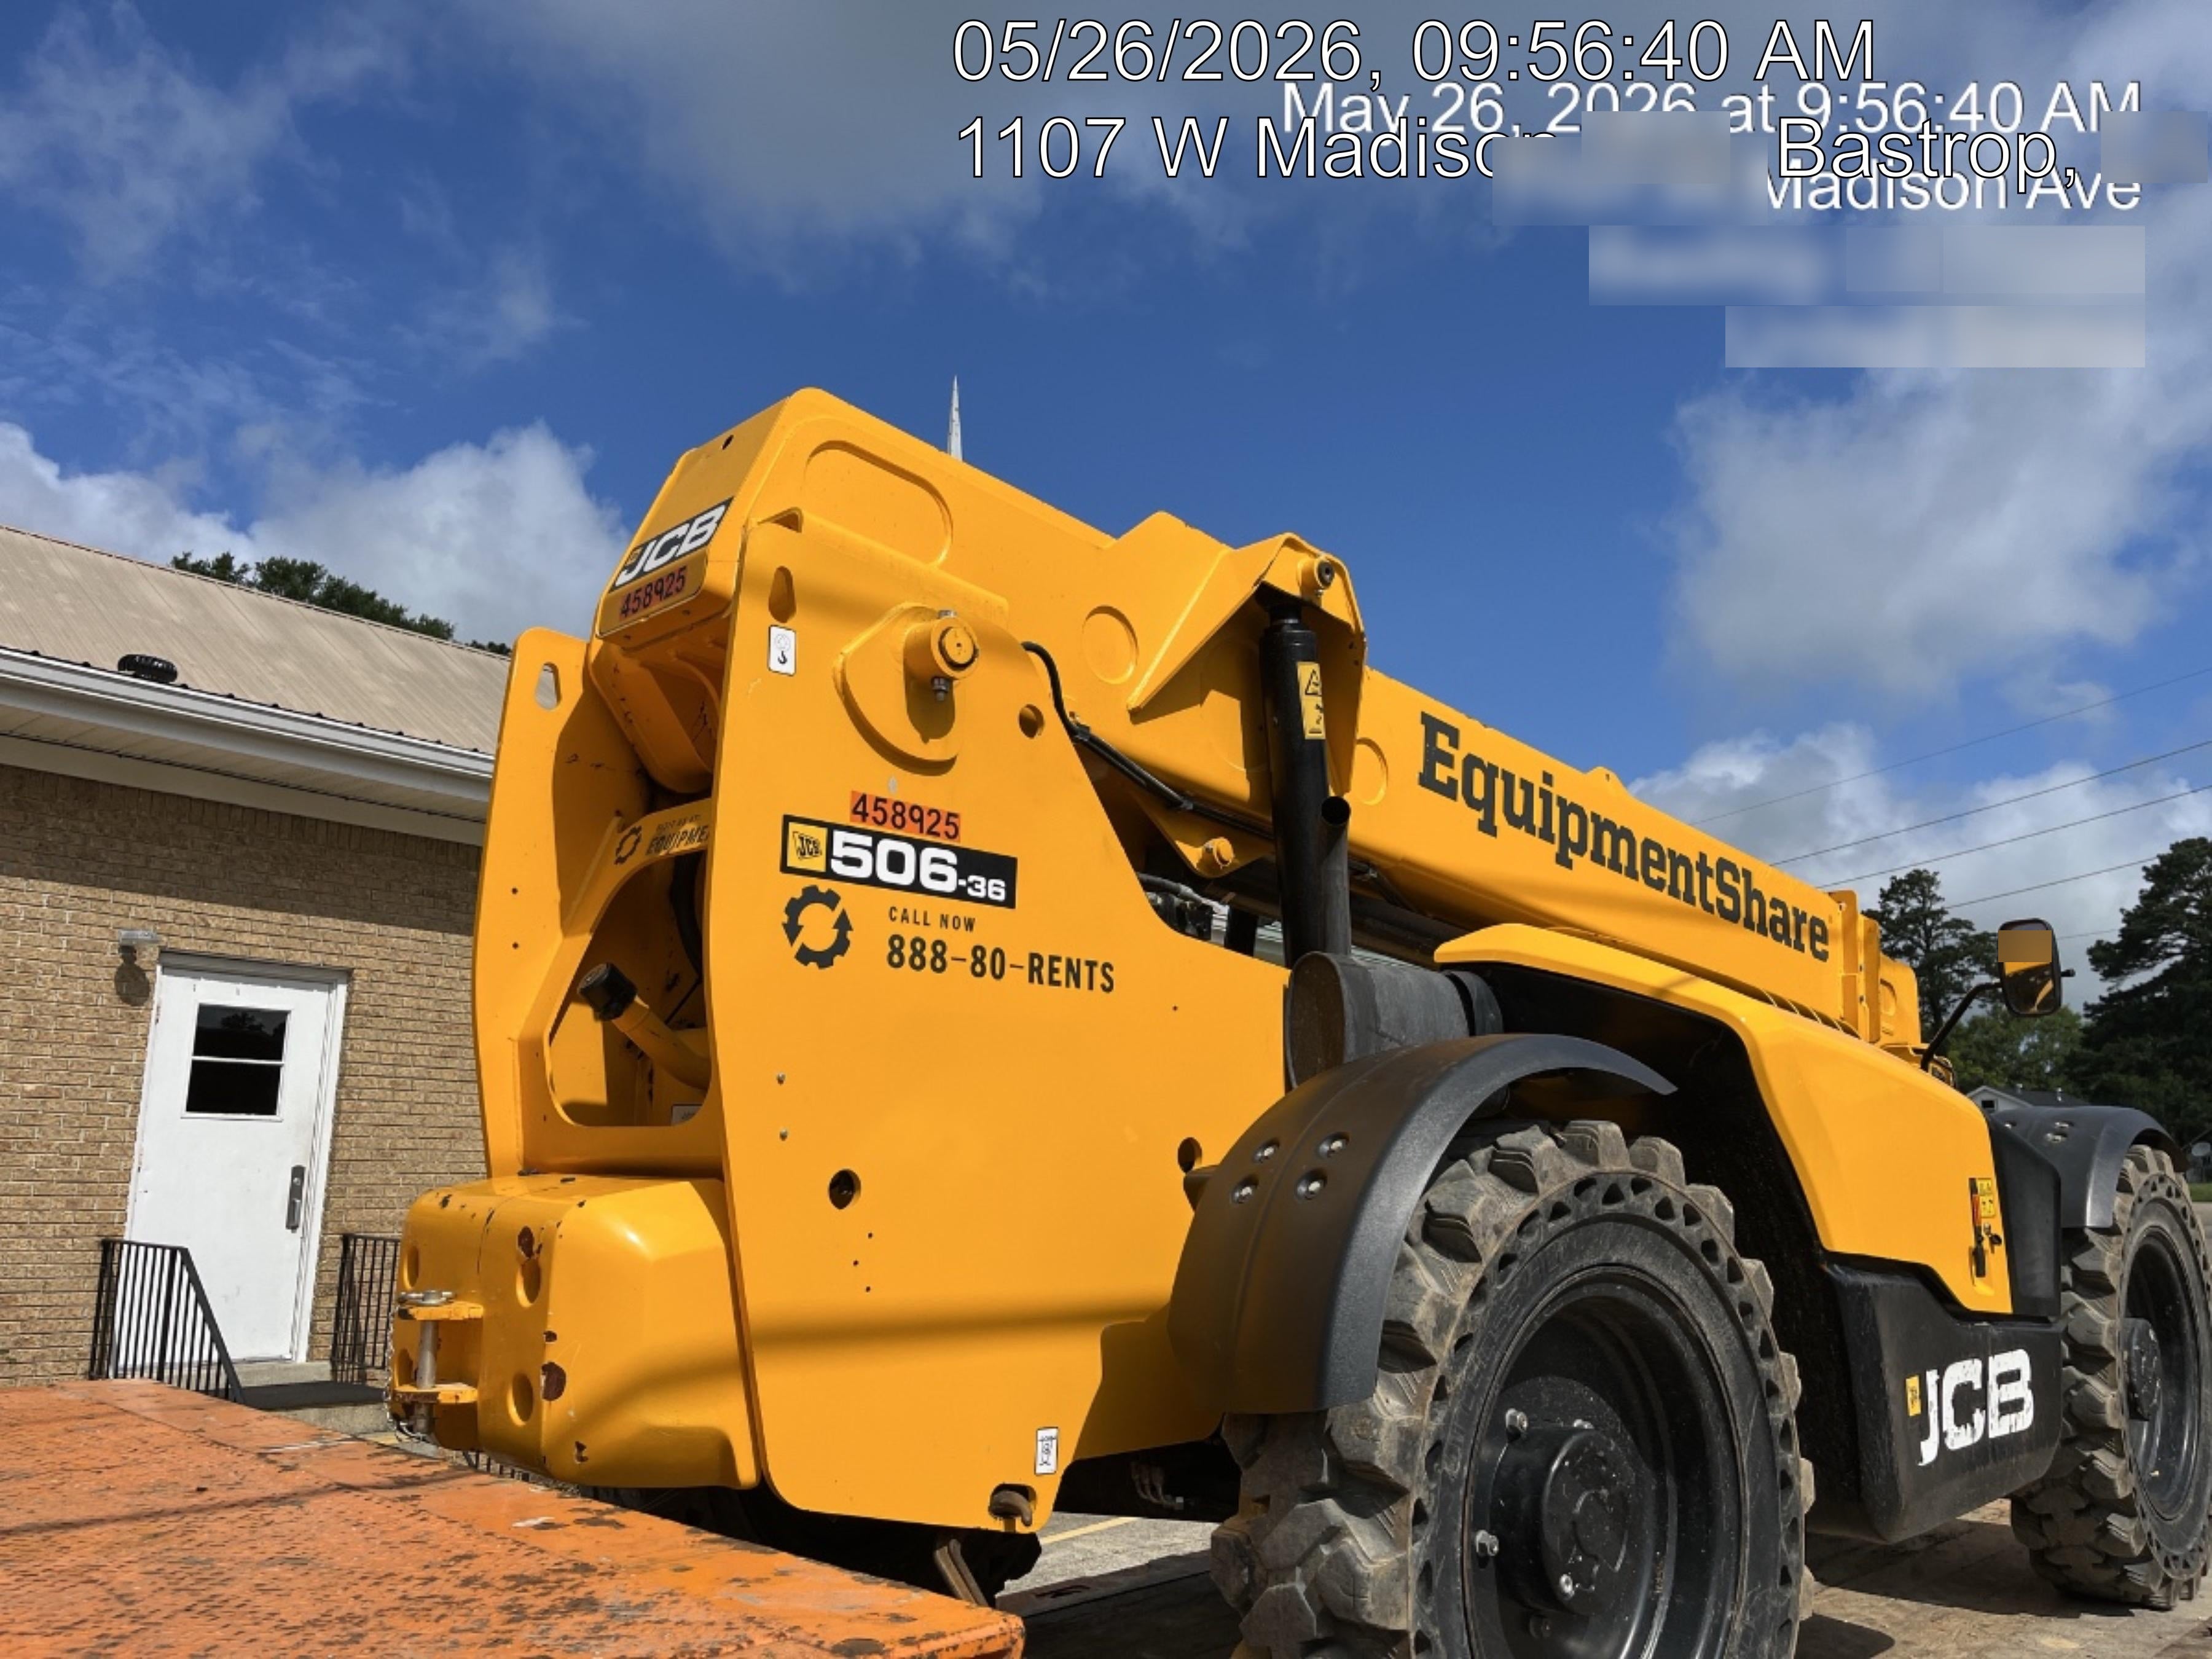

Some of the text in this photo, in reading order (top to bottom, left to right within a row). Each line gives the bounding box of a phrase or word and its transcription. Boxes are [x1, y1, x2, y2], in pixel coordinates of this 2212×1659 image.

[614, 504, 726, 588] JCB
[620, 565, 688, 618] 458925
[851, 793, 960, 840] 458925
[1418, 711, 1829, 963] EquipmentShare
[830, 829, 1006, 903] 506-36
[889, 906, 976, 933] CALL NOW
[887, 933, 1115, 994] 888-80-RENTS
[1916, 1349, 2034, 1466] JCB
